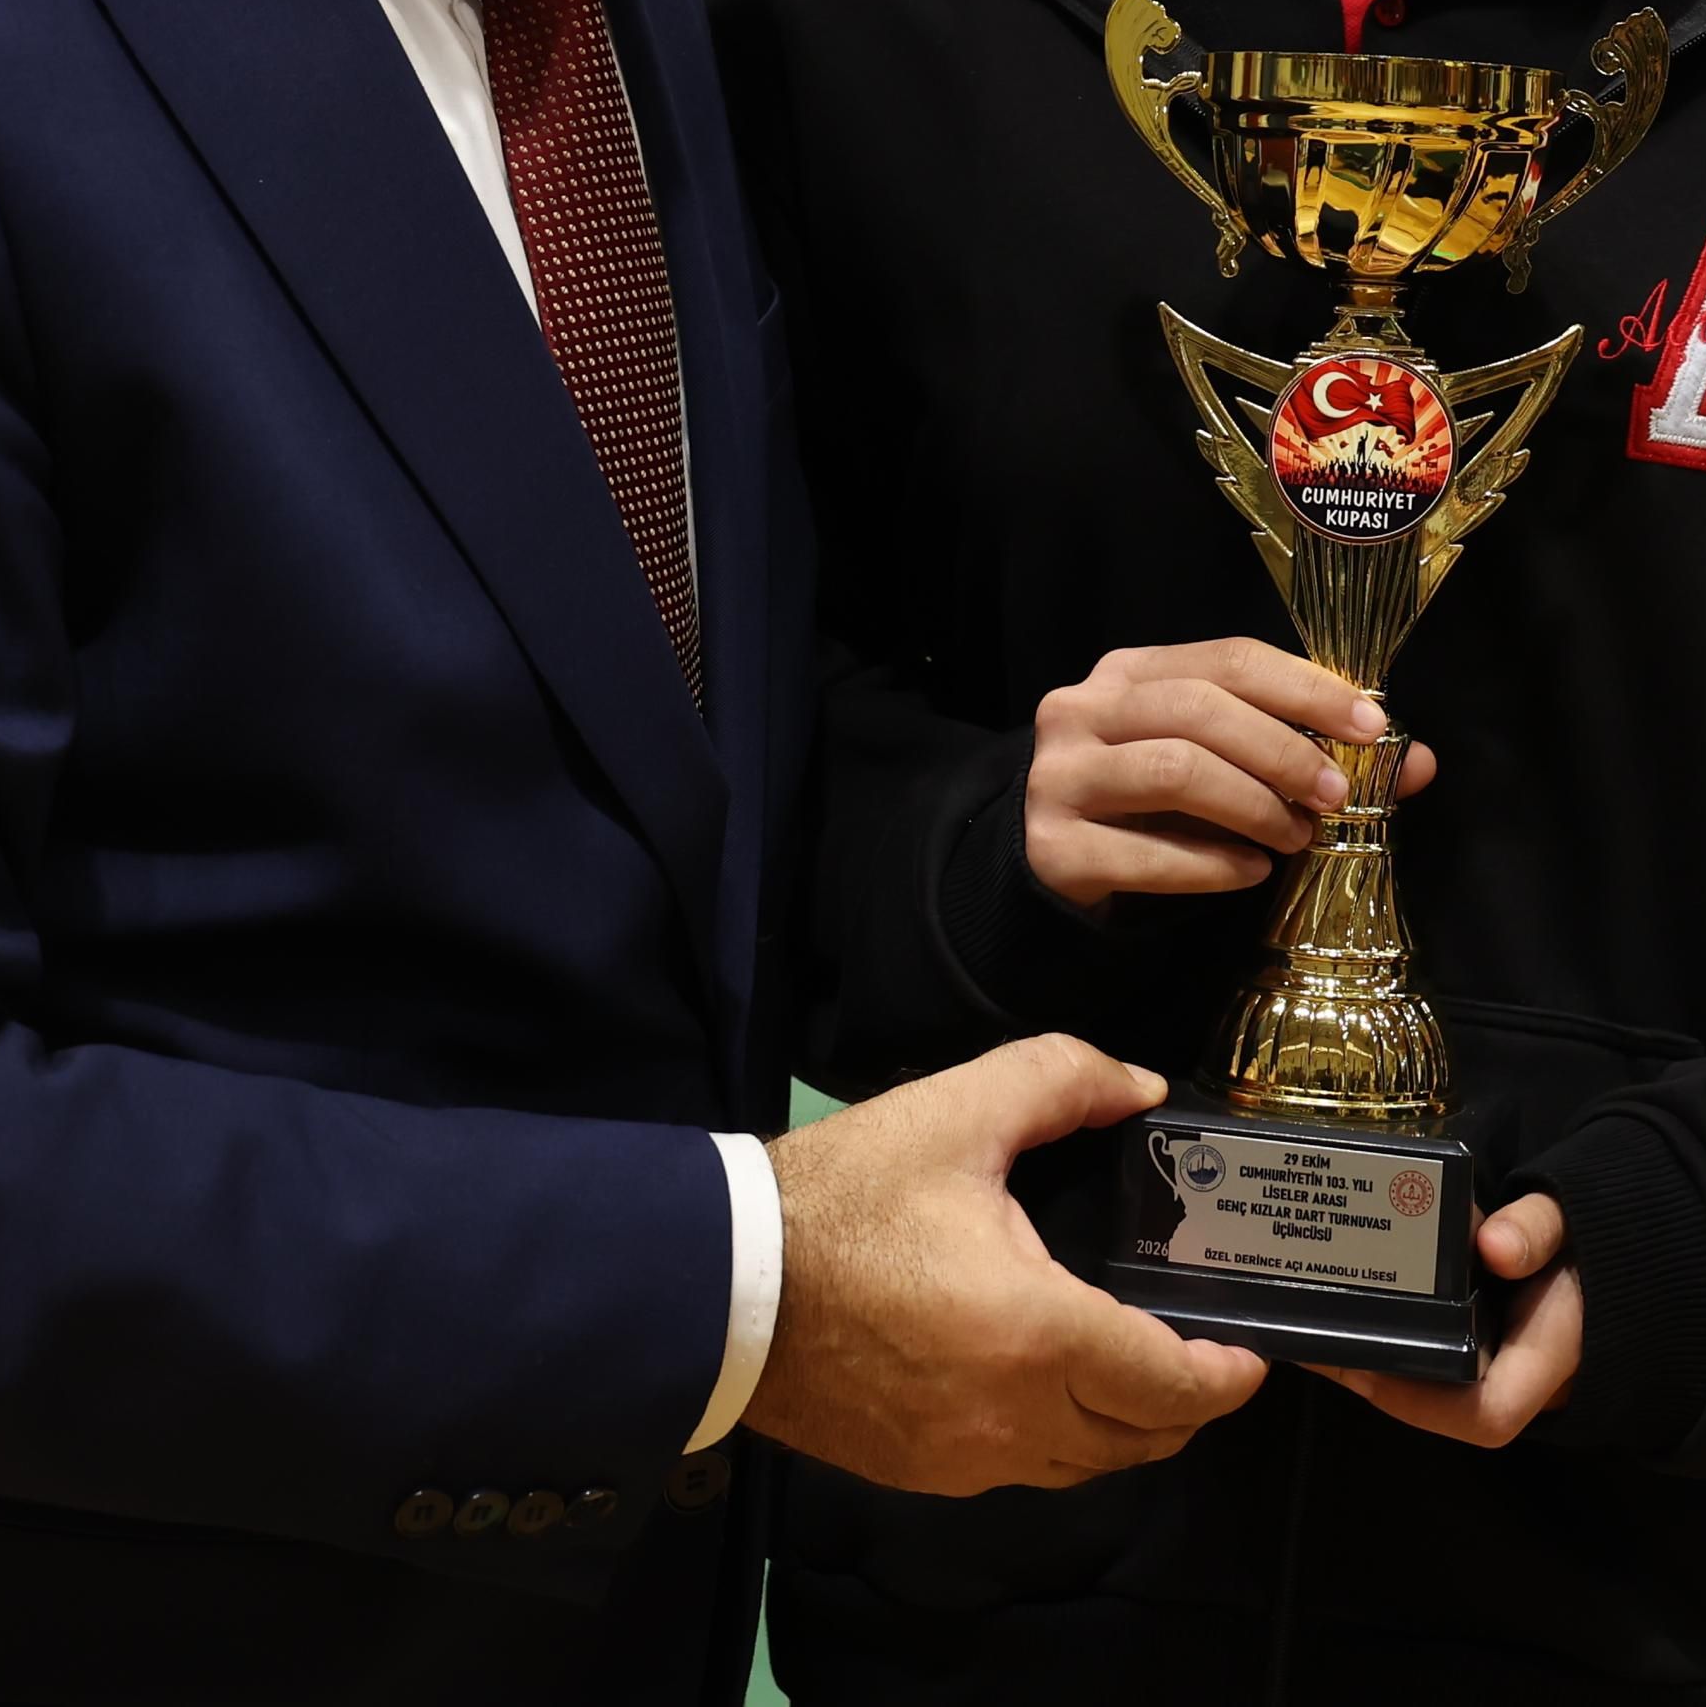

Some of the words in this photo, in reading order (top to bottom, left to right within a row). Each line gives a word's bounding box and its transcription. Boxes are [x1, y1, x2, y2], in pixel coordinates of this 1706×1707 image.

[1301, 486, 1416, 510] CUMHURİYET
[1325, 509, 1389, 530] KUPASI
[1284, 1152, 1299, 1166] 29
[1302, 1154, 1331, 1169] EKİM
[1239, 1165, 1323, 1187] CUMHURİYETİN
[1326, 1176, 1349, 1190] 103.
[1352, 1179, 1374, 1193] YILI
[1262, 1184, 1309, 1203] LİSELER
[1312, 1193, 1348, 1208] ARASI
[1216, 1198, 1247, 1217] GENÇ
[1250, 1203, 1291, 1219] KIZLAR
[1295, 1208, 1325, 1223] DART
[1328, 1212, 1392, 1231] TURNUVASI
[1272, 1220, 1333, 1242] ÜÇÜNCÜSÜ
[1136, 1239, 1169, 1257] 2026
[1204, 1247, 1231, 1263] ÖZEL
[1234, 1253, 1282, 1269] DERİNCE
[1285, 1260, 1303, 1273] AÇI
[1305, 1263, 1359, 1278] ANADOLU
[1361, 1267, 1397, 1283] LİSESİ
